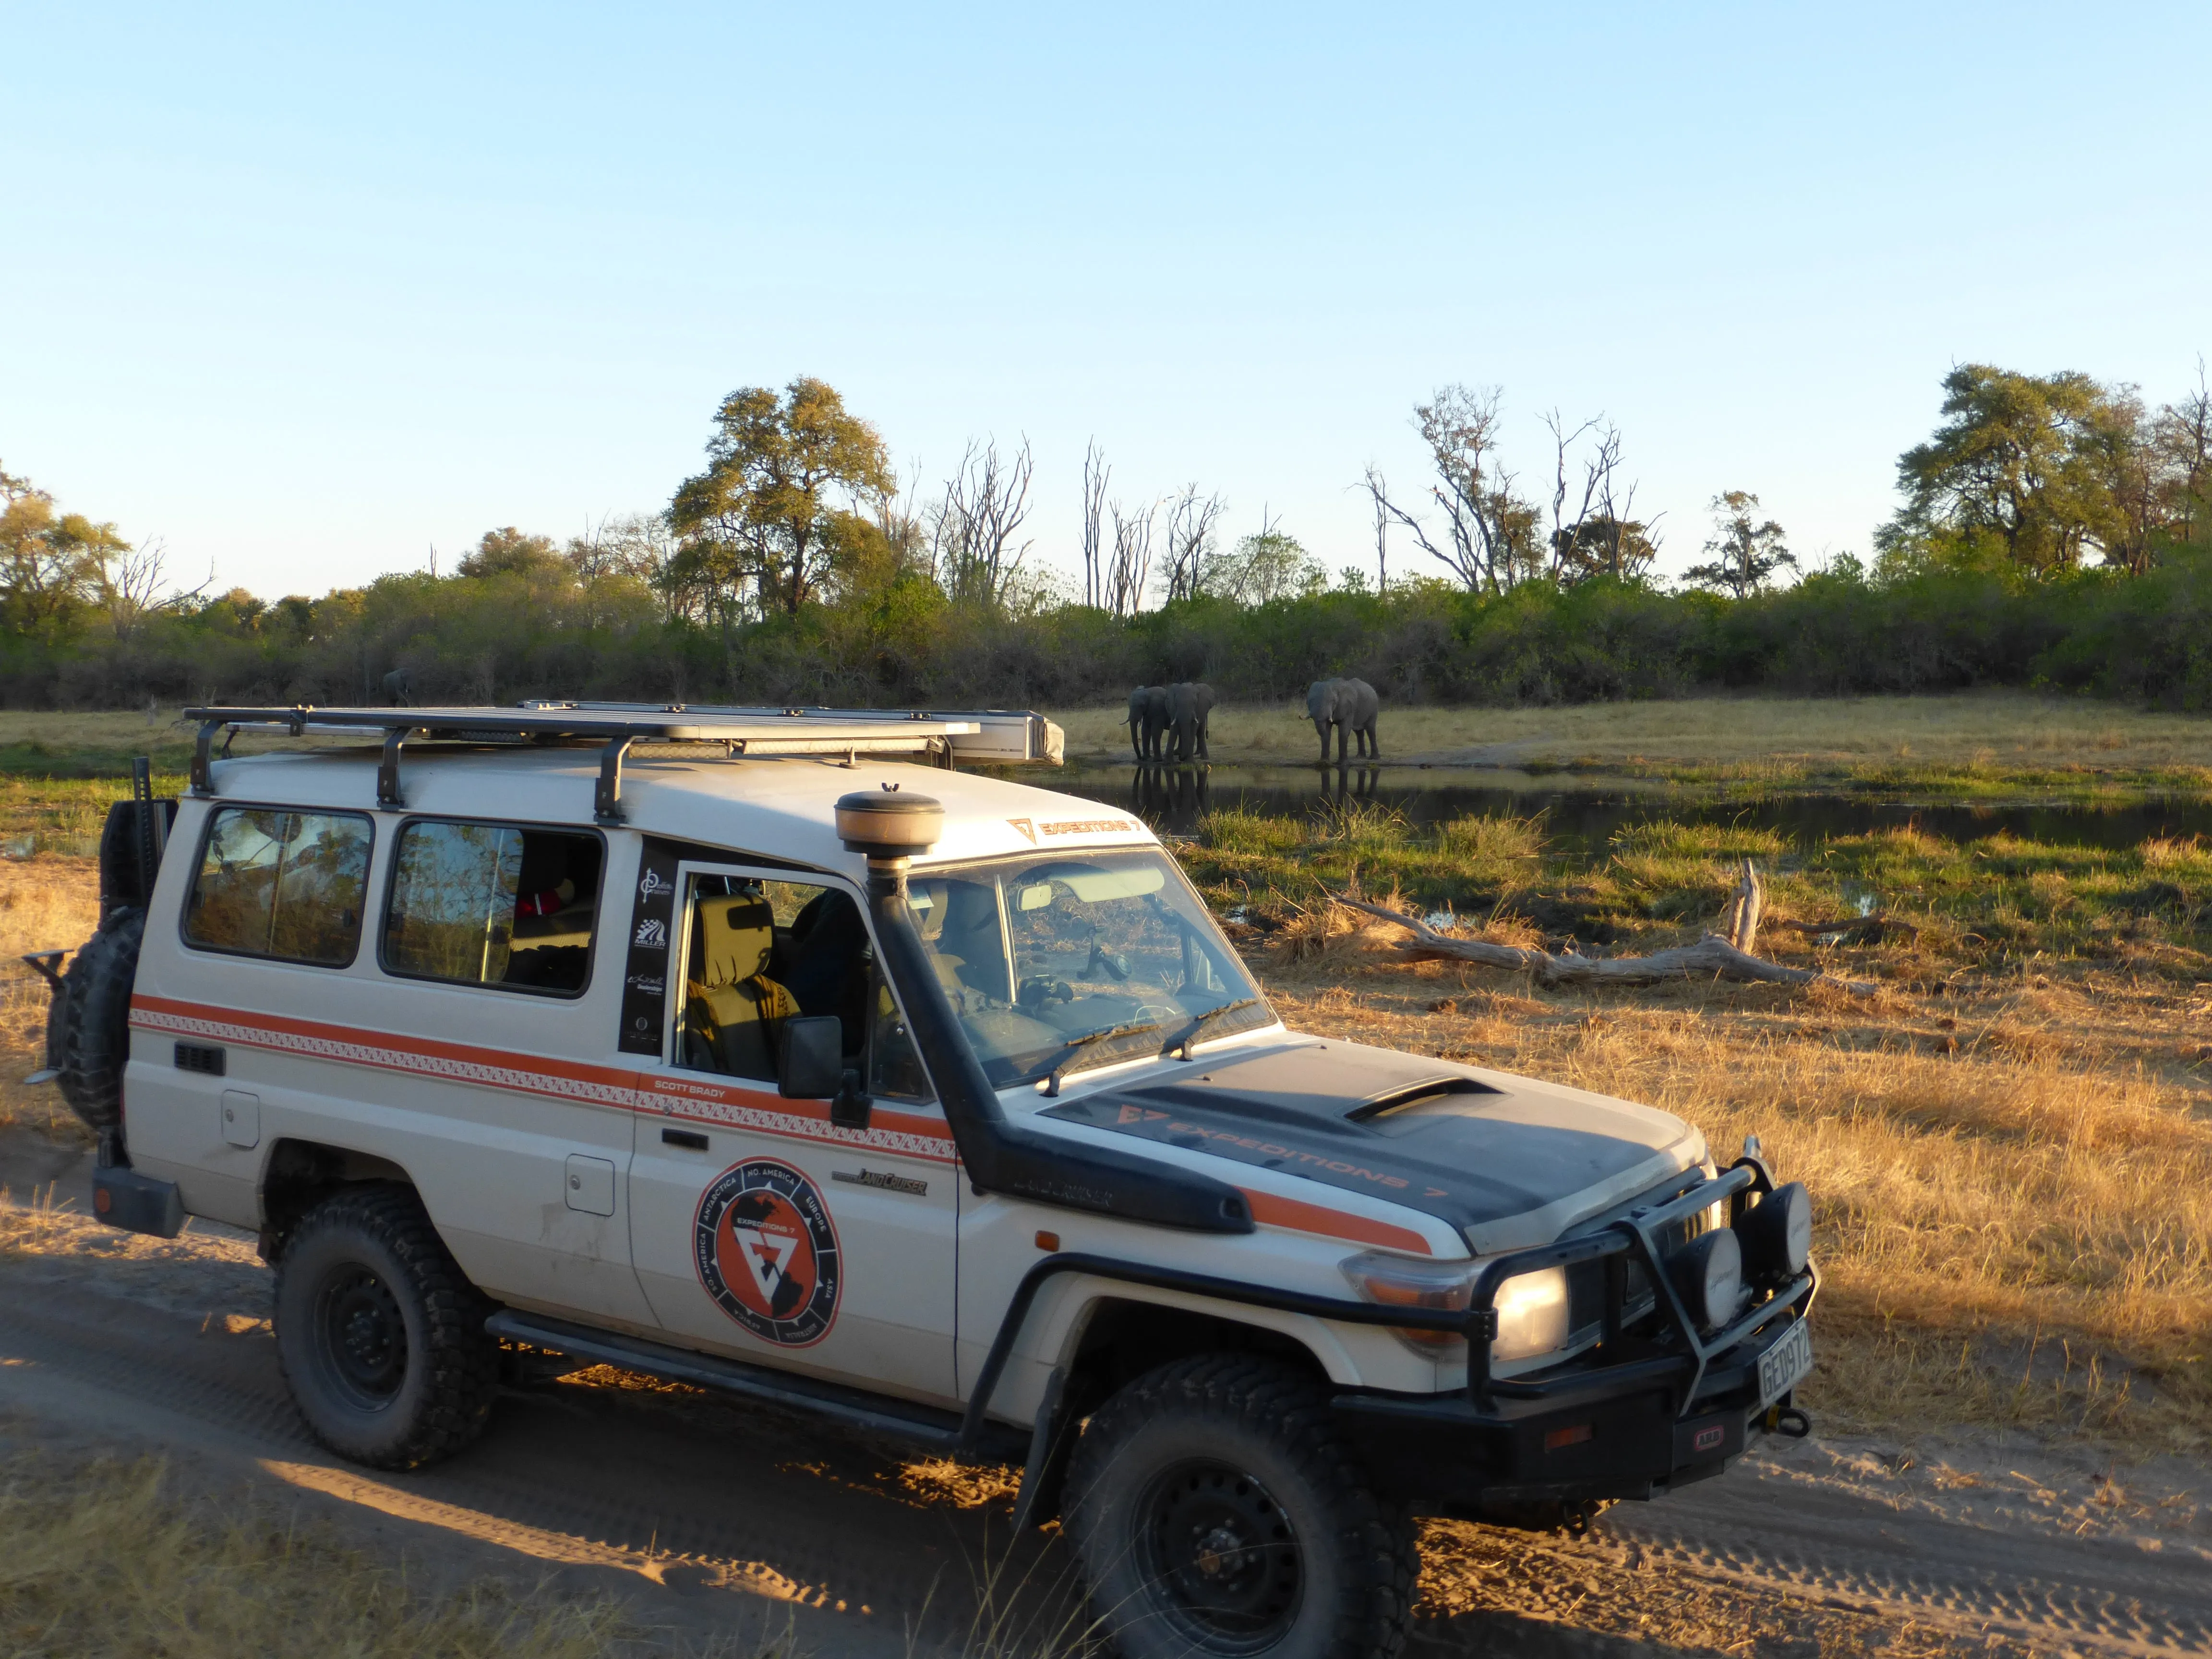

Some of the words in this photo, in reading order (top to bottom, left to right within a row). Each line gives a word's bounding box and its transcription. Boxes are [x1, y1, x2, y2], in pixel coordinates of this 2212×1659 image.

[1038, 820, 1131, 836] EXPEDITIONS
[1130, 820, 1141, 831] 7
[634, 938, 666, 947] MILLER
[655, 1080, 689, 1092] SCOTT
[689, 1085, 726, 1098] BRADY
[1166, 1122, 1409, 1189] EXPEDITIONS
[1423, 1187, 1449, 1197] 7
[747, 1168, 761, 1178] NO.
[762, 1168, 795, 1185] AMERICA
[703, 1177, 737, 1222] ANTARCTICA
[805, 1195, 827, 1233] EUROPE
[737, 1217, 788, 1233] EXPEDITIONS
[699, 1233, 710, 1274] AMERICA
[824, 1277, 834, 1298] ASIA
